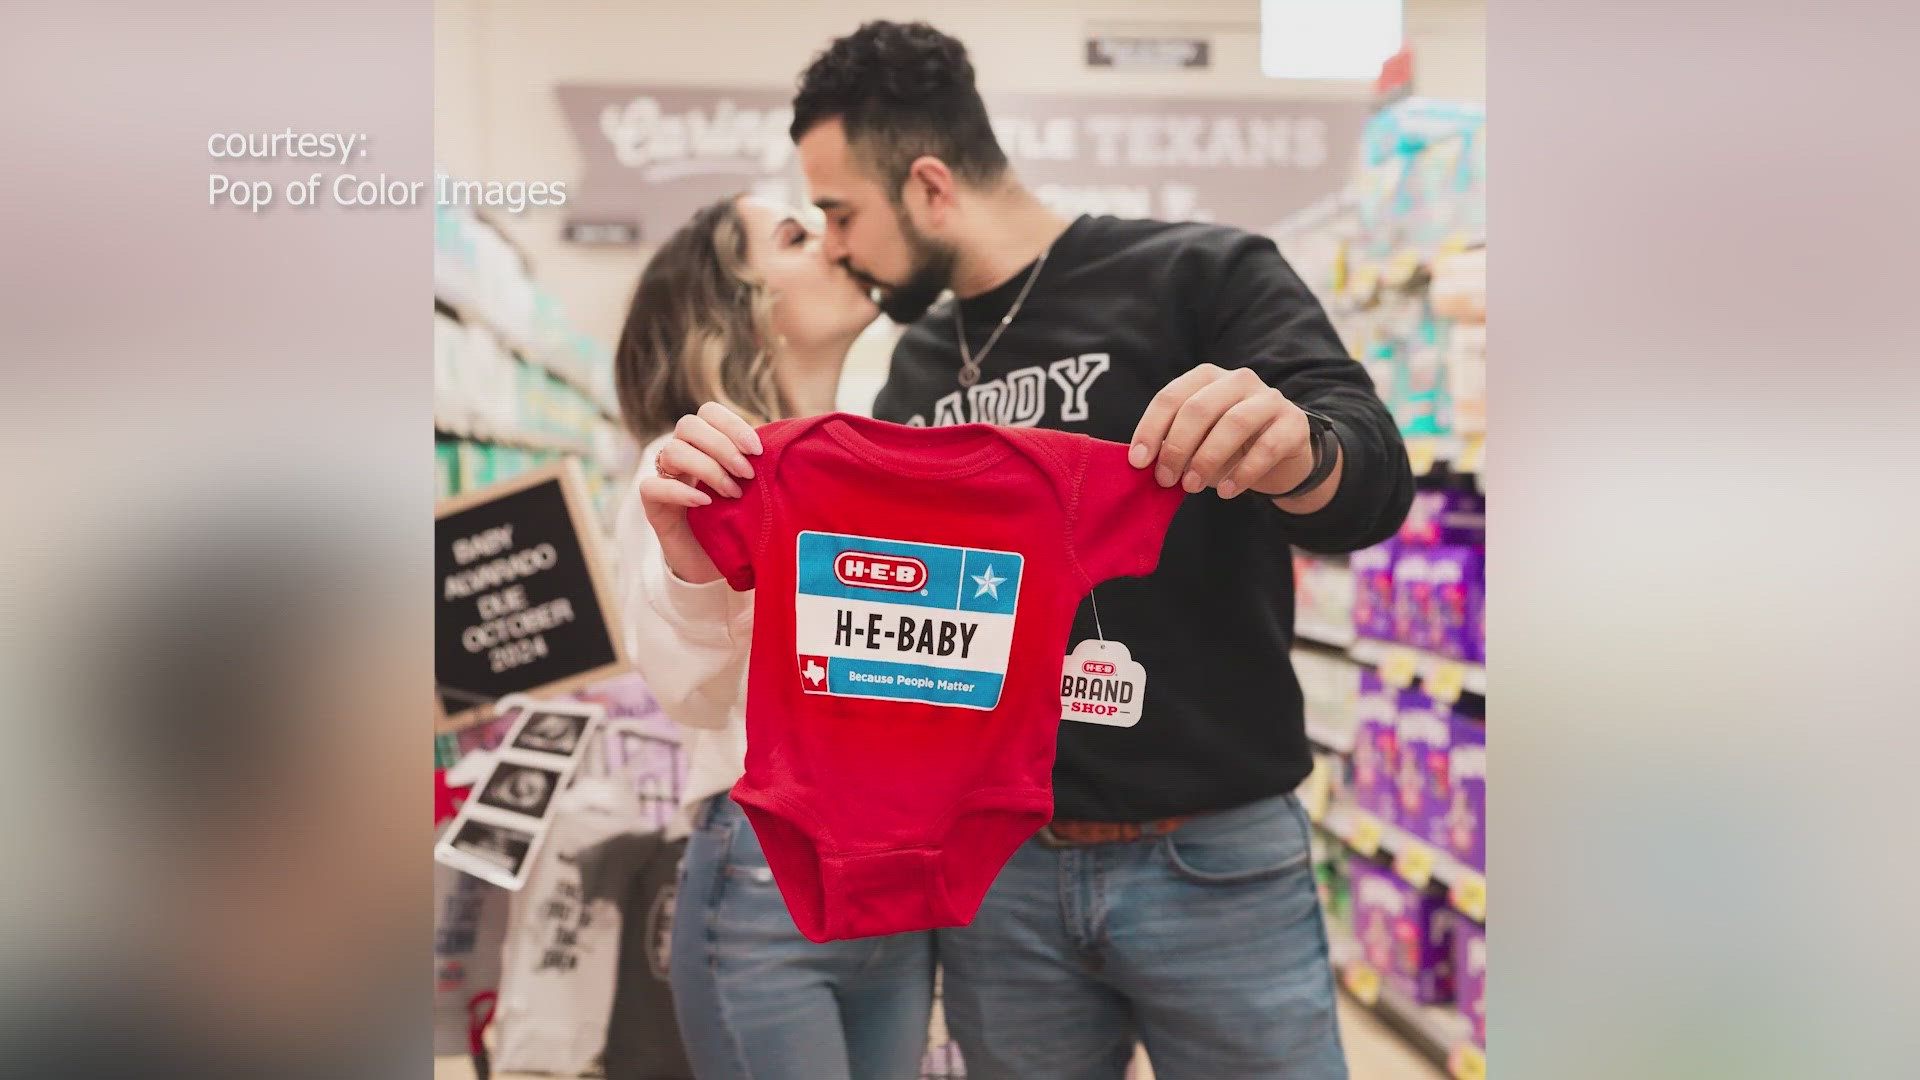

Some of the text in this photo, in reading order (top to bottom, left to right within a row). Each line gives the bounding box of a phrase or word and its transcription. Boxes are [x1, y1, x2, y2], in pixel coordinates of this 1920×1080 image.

[1087, 114, 1329, 168] TEXANS
[906, 352, 1111, 428] ADDY
[476, 583, 528, 621] DUE
[462, 597, 575, 653] OCTOBER
[834, 609, 978, 659] H-E-BABY
[849, 670, 975, 693] Because People Matter
[1060, 675, 1134, 704] BRAND
[1071, 701, 1118, 716] SHOP
